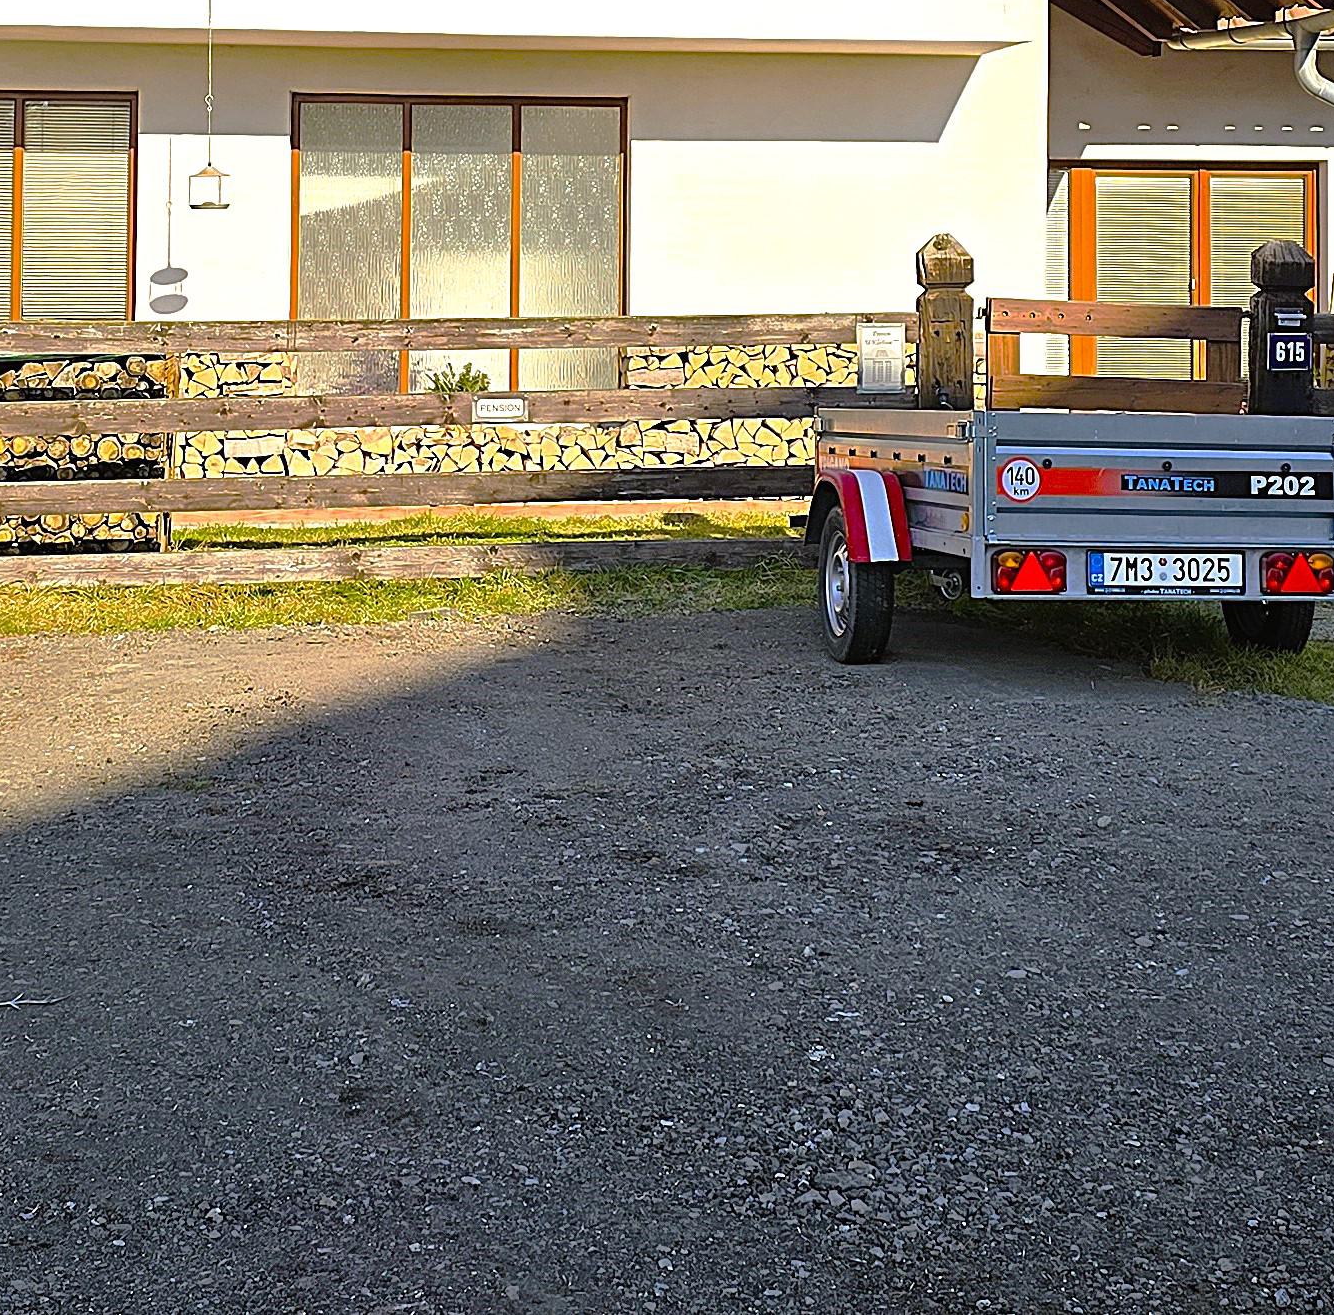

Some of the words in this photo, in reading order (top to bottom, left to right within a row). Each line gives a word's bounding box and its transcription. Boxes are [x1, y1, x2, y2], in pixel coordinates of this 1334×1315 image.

[1275, 341, 1305, 362] 615
[480, 404, 521, 413] PENSION
[925, 469, 967, 493] TANATECH
[1006, 466, 1036, 486] 140
[1250, 475, 1316, 496] P202
[1013, 487, 1030, 496] km
[1091, 573, 1104, 583] CZ
[1110, 556, 1153, 582] 7M3
[1172, 557, 1231, 583] 3025
